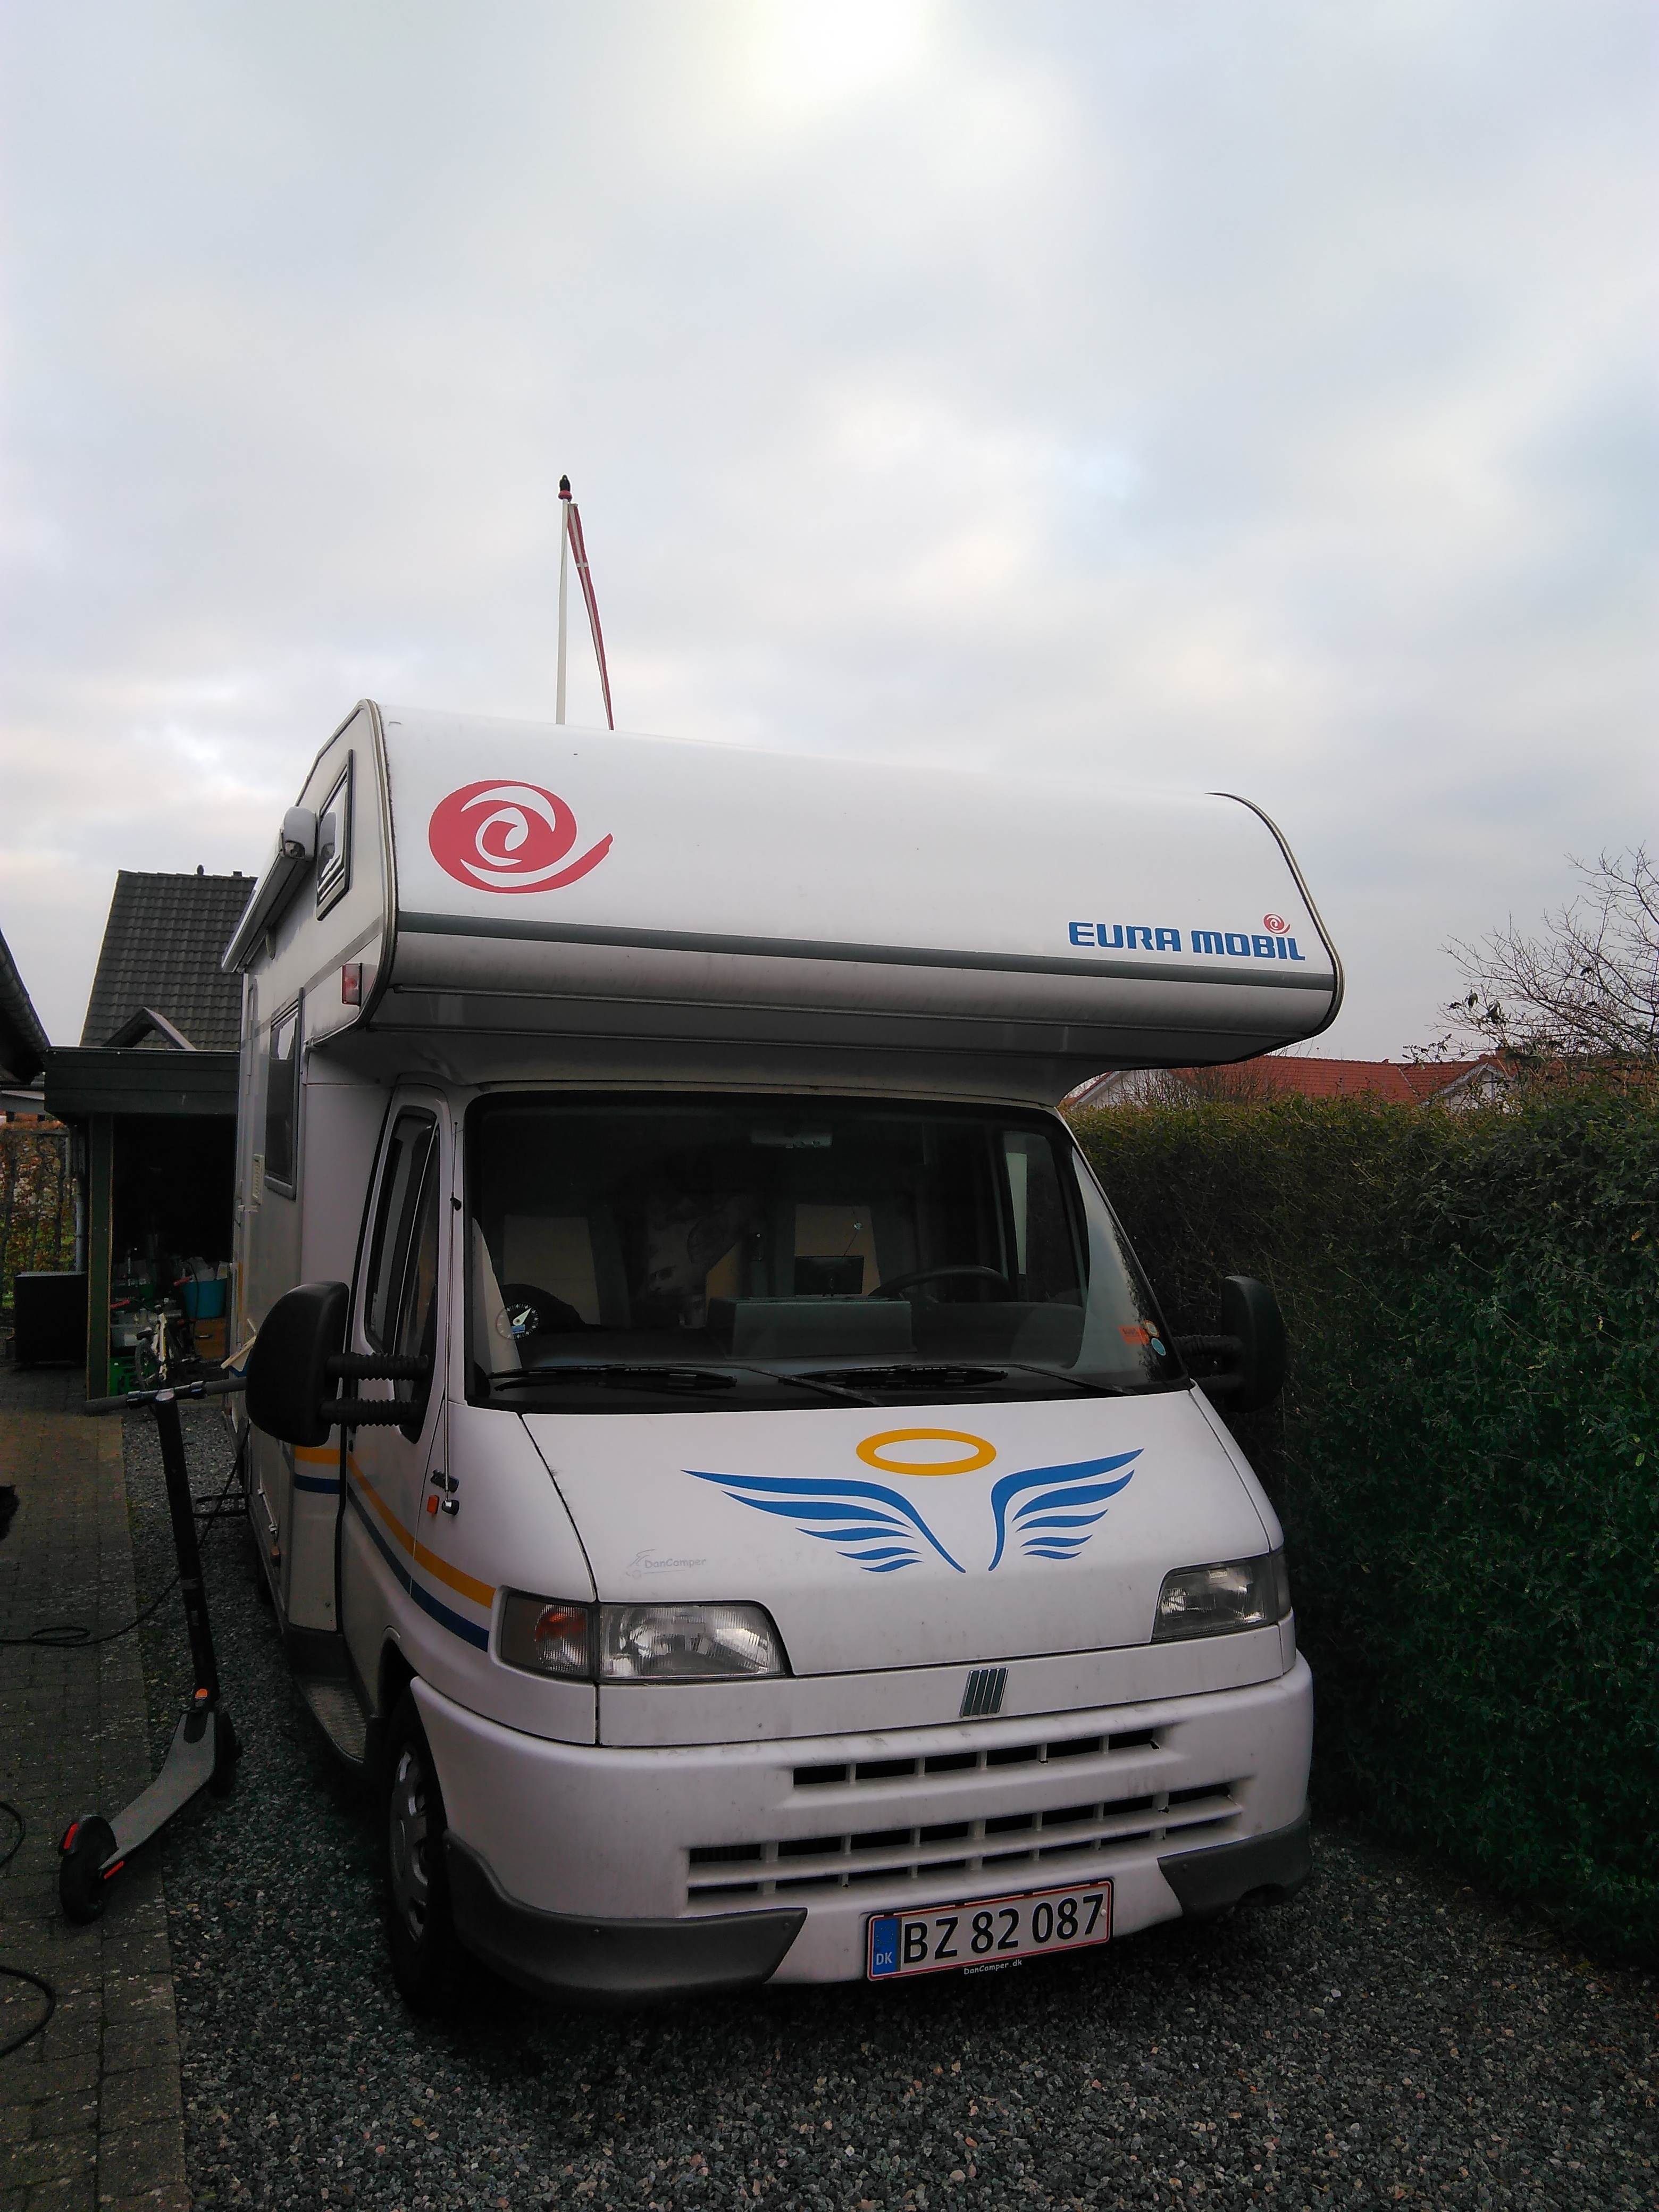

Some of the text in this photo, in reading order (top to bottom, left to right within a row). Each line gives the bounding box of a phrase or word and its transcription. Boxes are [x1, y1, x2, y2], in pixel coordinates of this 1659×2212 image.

[1068, 921, 1306, 961] EURA MOBIL
[644, 1559, 707, 1569] DanCamper
[903, 1893, 1104, 1964] BZ 82 087
[876, 1951, 893, 1966] DK
